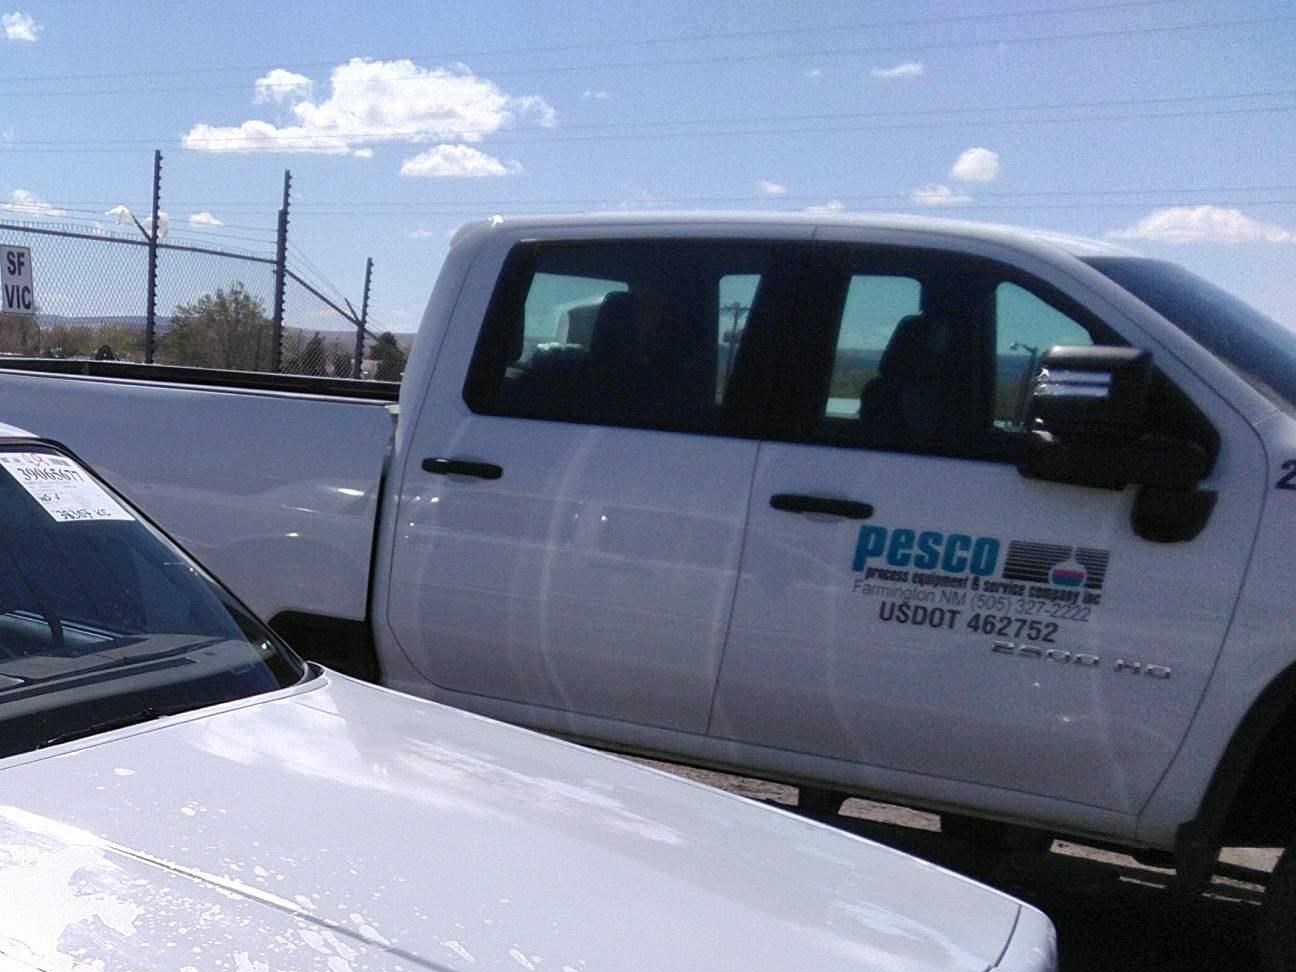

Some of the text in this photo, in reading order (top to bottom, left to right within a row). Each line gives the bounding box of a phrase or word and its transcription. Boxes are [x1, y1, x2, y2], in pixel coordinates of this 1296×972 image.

[6, 252, 26, 277] SF
[3, 283, 33, 311] VIC
[17, 467, 85, 481] 39065677
[852, 578, 1092, 623] Farmington NM (505) 327-2222
[864, 567, 910, 583] process
[911, 572, 969, 588] equipment
[971, 576, 980, 591] &
[982, 580, 1026, 596] service
[1029, 585, 1081, 605] company
[879, 601, 1059, 643] USDOT 462752
[991, 639, 1172, 680] 2500 HD
